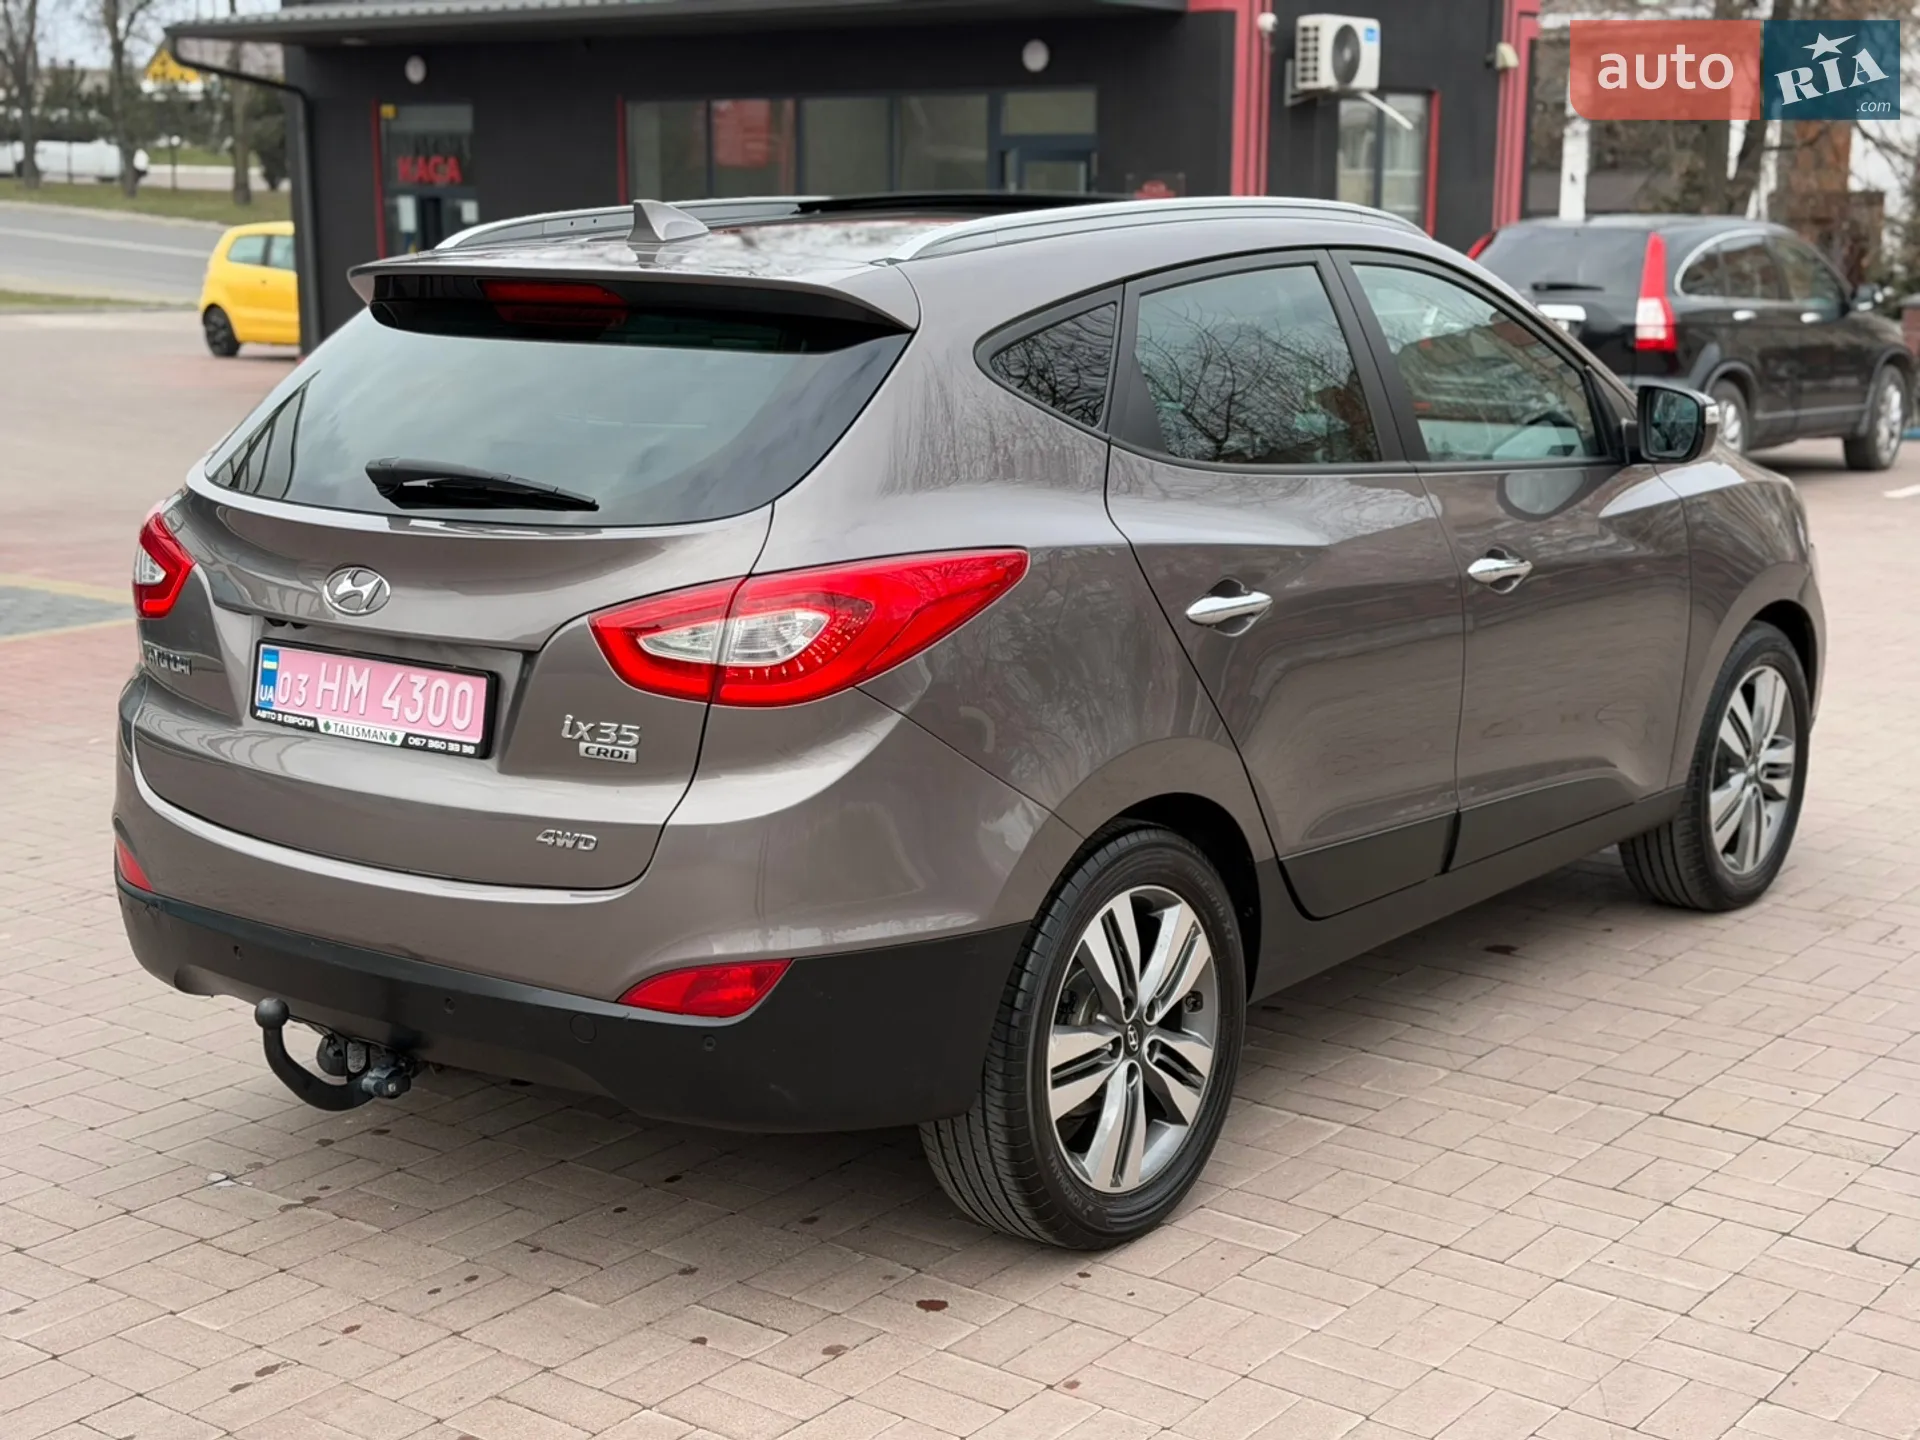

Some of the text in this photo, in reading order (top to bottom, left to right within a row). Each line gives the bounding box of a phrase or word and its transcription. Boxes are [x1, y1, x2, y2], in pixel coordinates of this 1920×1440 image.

[259, 685, 275, 703] UA
[277, 661, 475, 731] 03 HM 4300
[333, 722, 388, 742] TALISMAN
[584, 745, 630, 760] CRDi
[536, 829, 598, 851] 4WD
